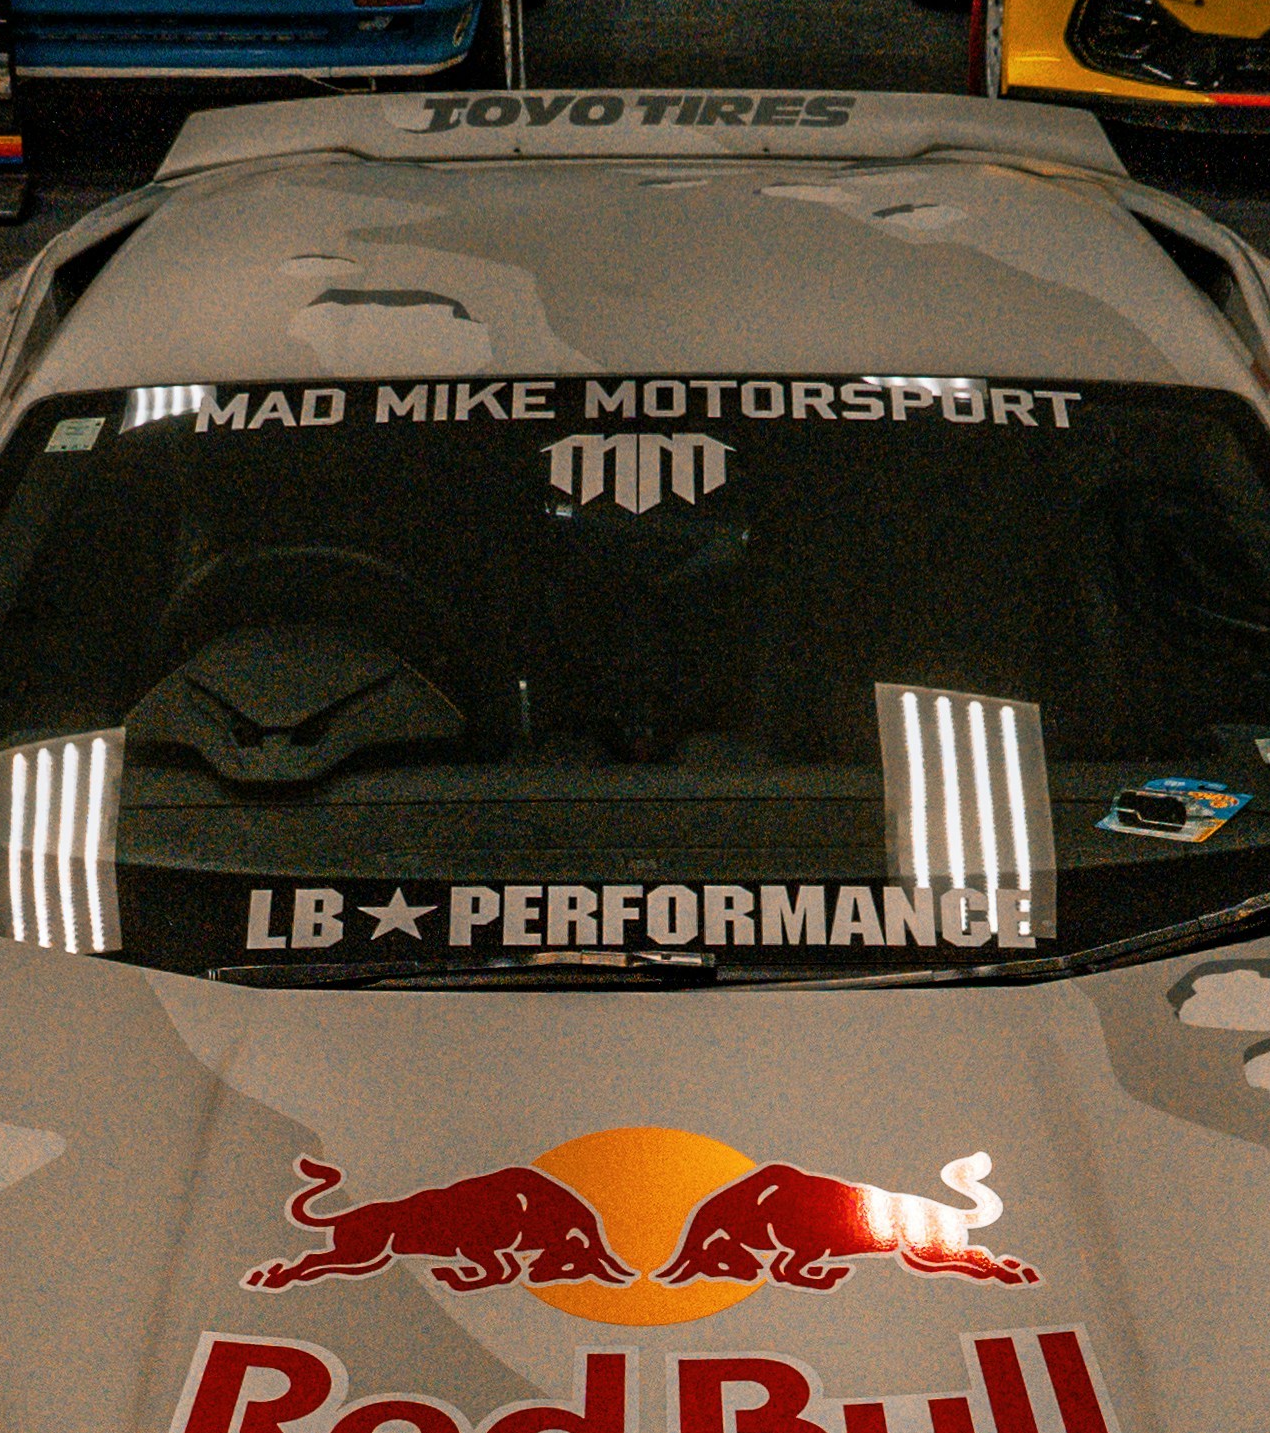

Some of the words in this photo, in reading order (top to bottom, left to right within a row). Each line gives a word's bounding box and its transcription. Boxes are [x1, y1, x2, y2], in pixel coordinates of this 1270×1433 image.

[427, 98, 625, 130] TOYO
[640, 96, 855, 128] TIRES
[195, 386, 346, 435] MAD
[375, 380, 556, 424] MIKE
[584, 378, 1082, 430] MOTORSPORT
[246, 890, 344, 952] LB
[449, 884, 1038, 951] PERFORMANCE
